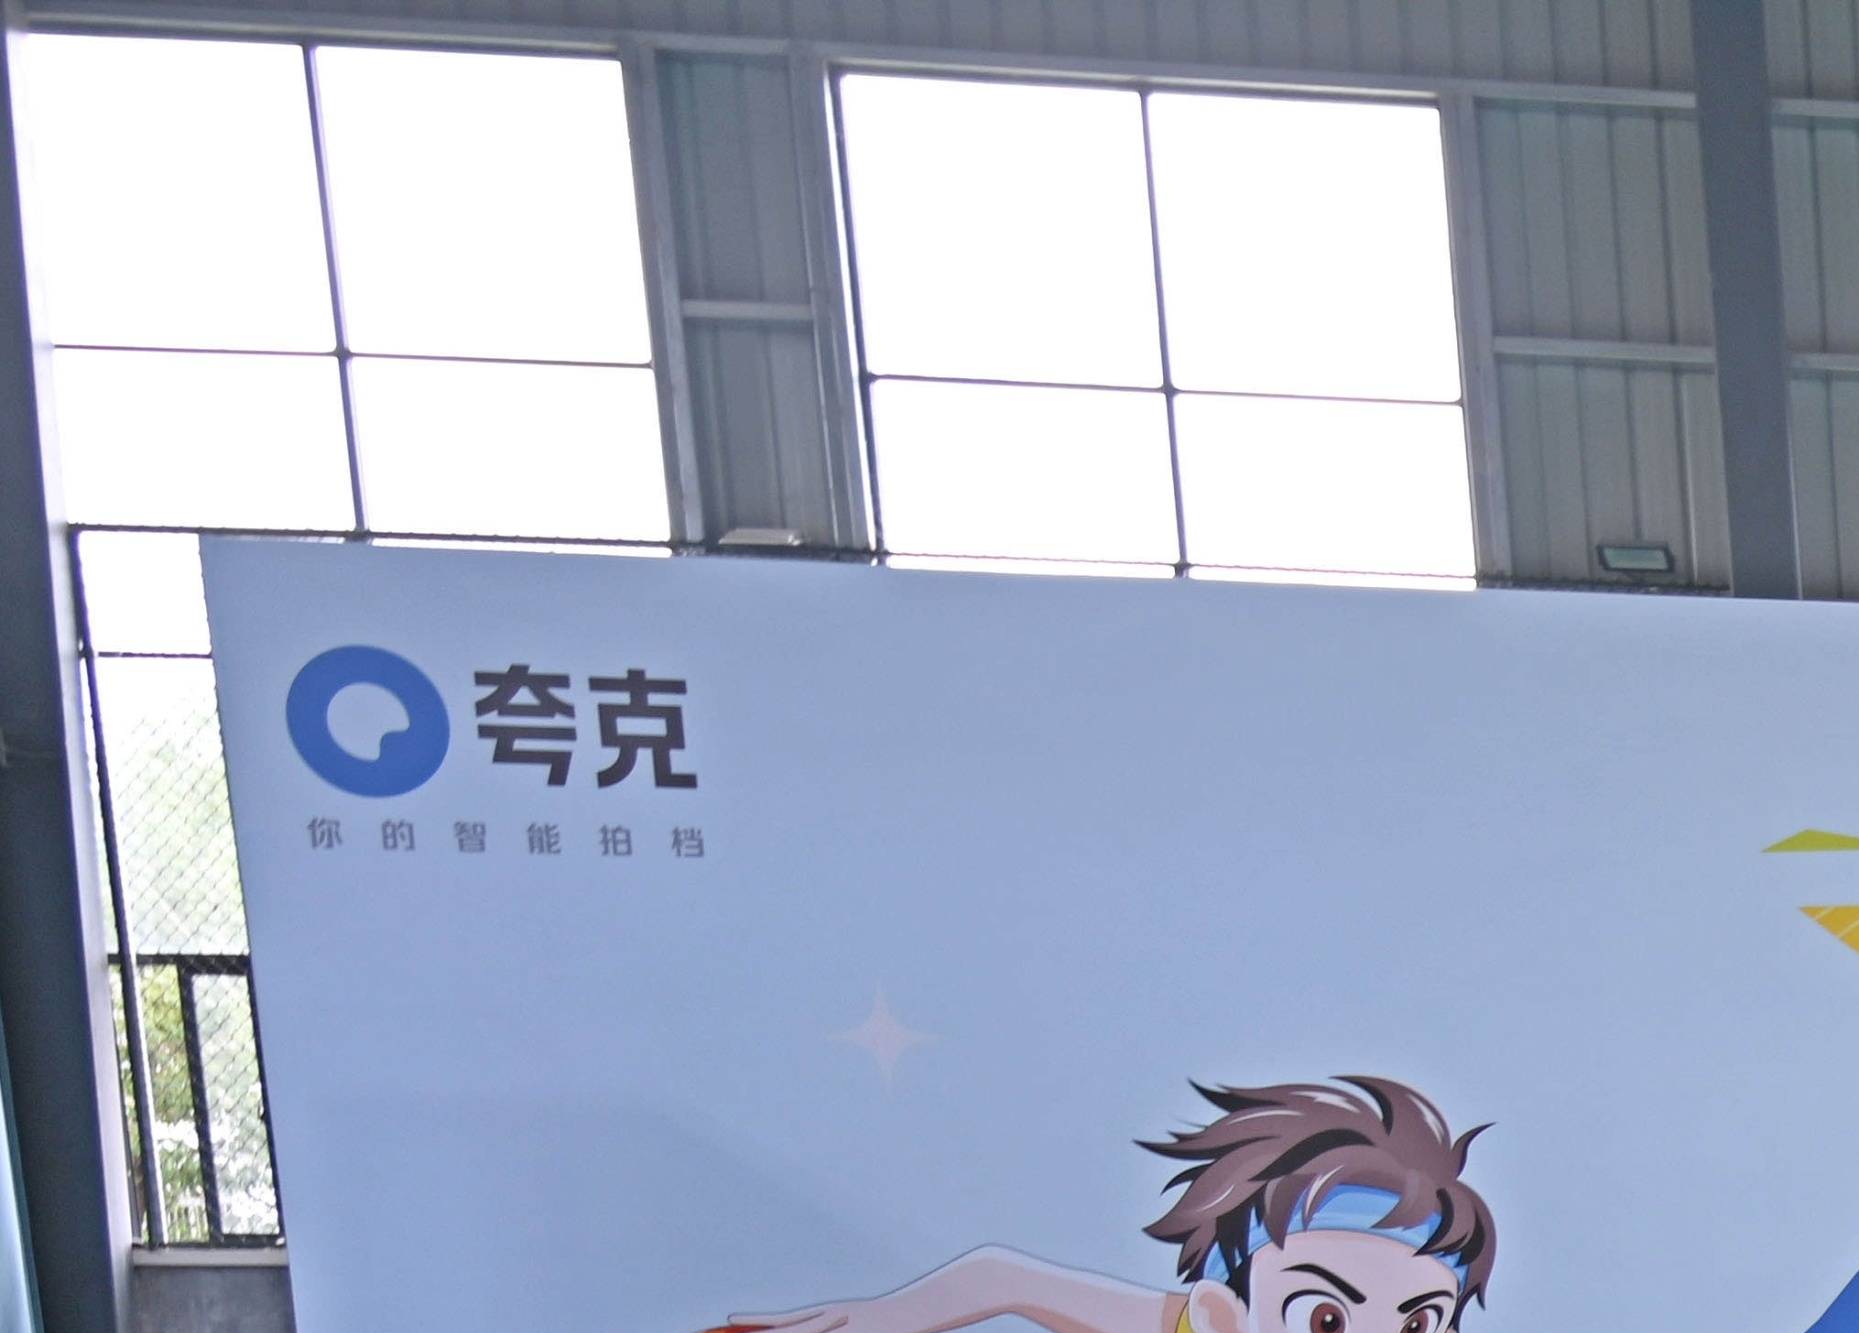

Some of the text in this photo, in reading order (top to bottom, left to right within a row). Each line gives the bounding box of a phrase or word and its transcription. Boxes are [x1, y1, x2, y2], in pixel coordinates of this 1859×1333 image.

[472, 662, 699, 790] 夸克
[306, 817, 704, 859] 你的智能拍档
